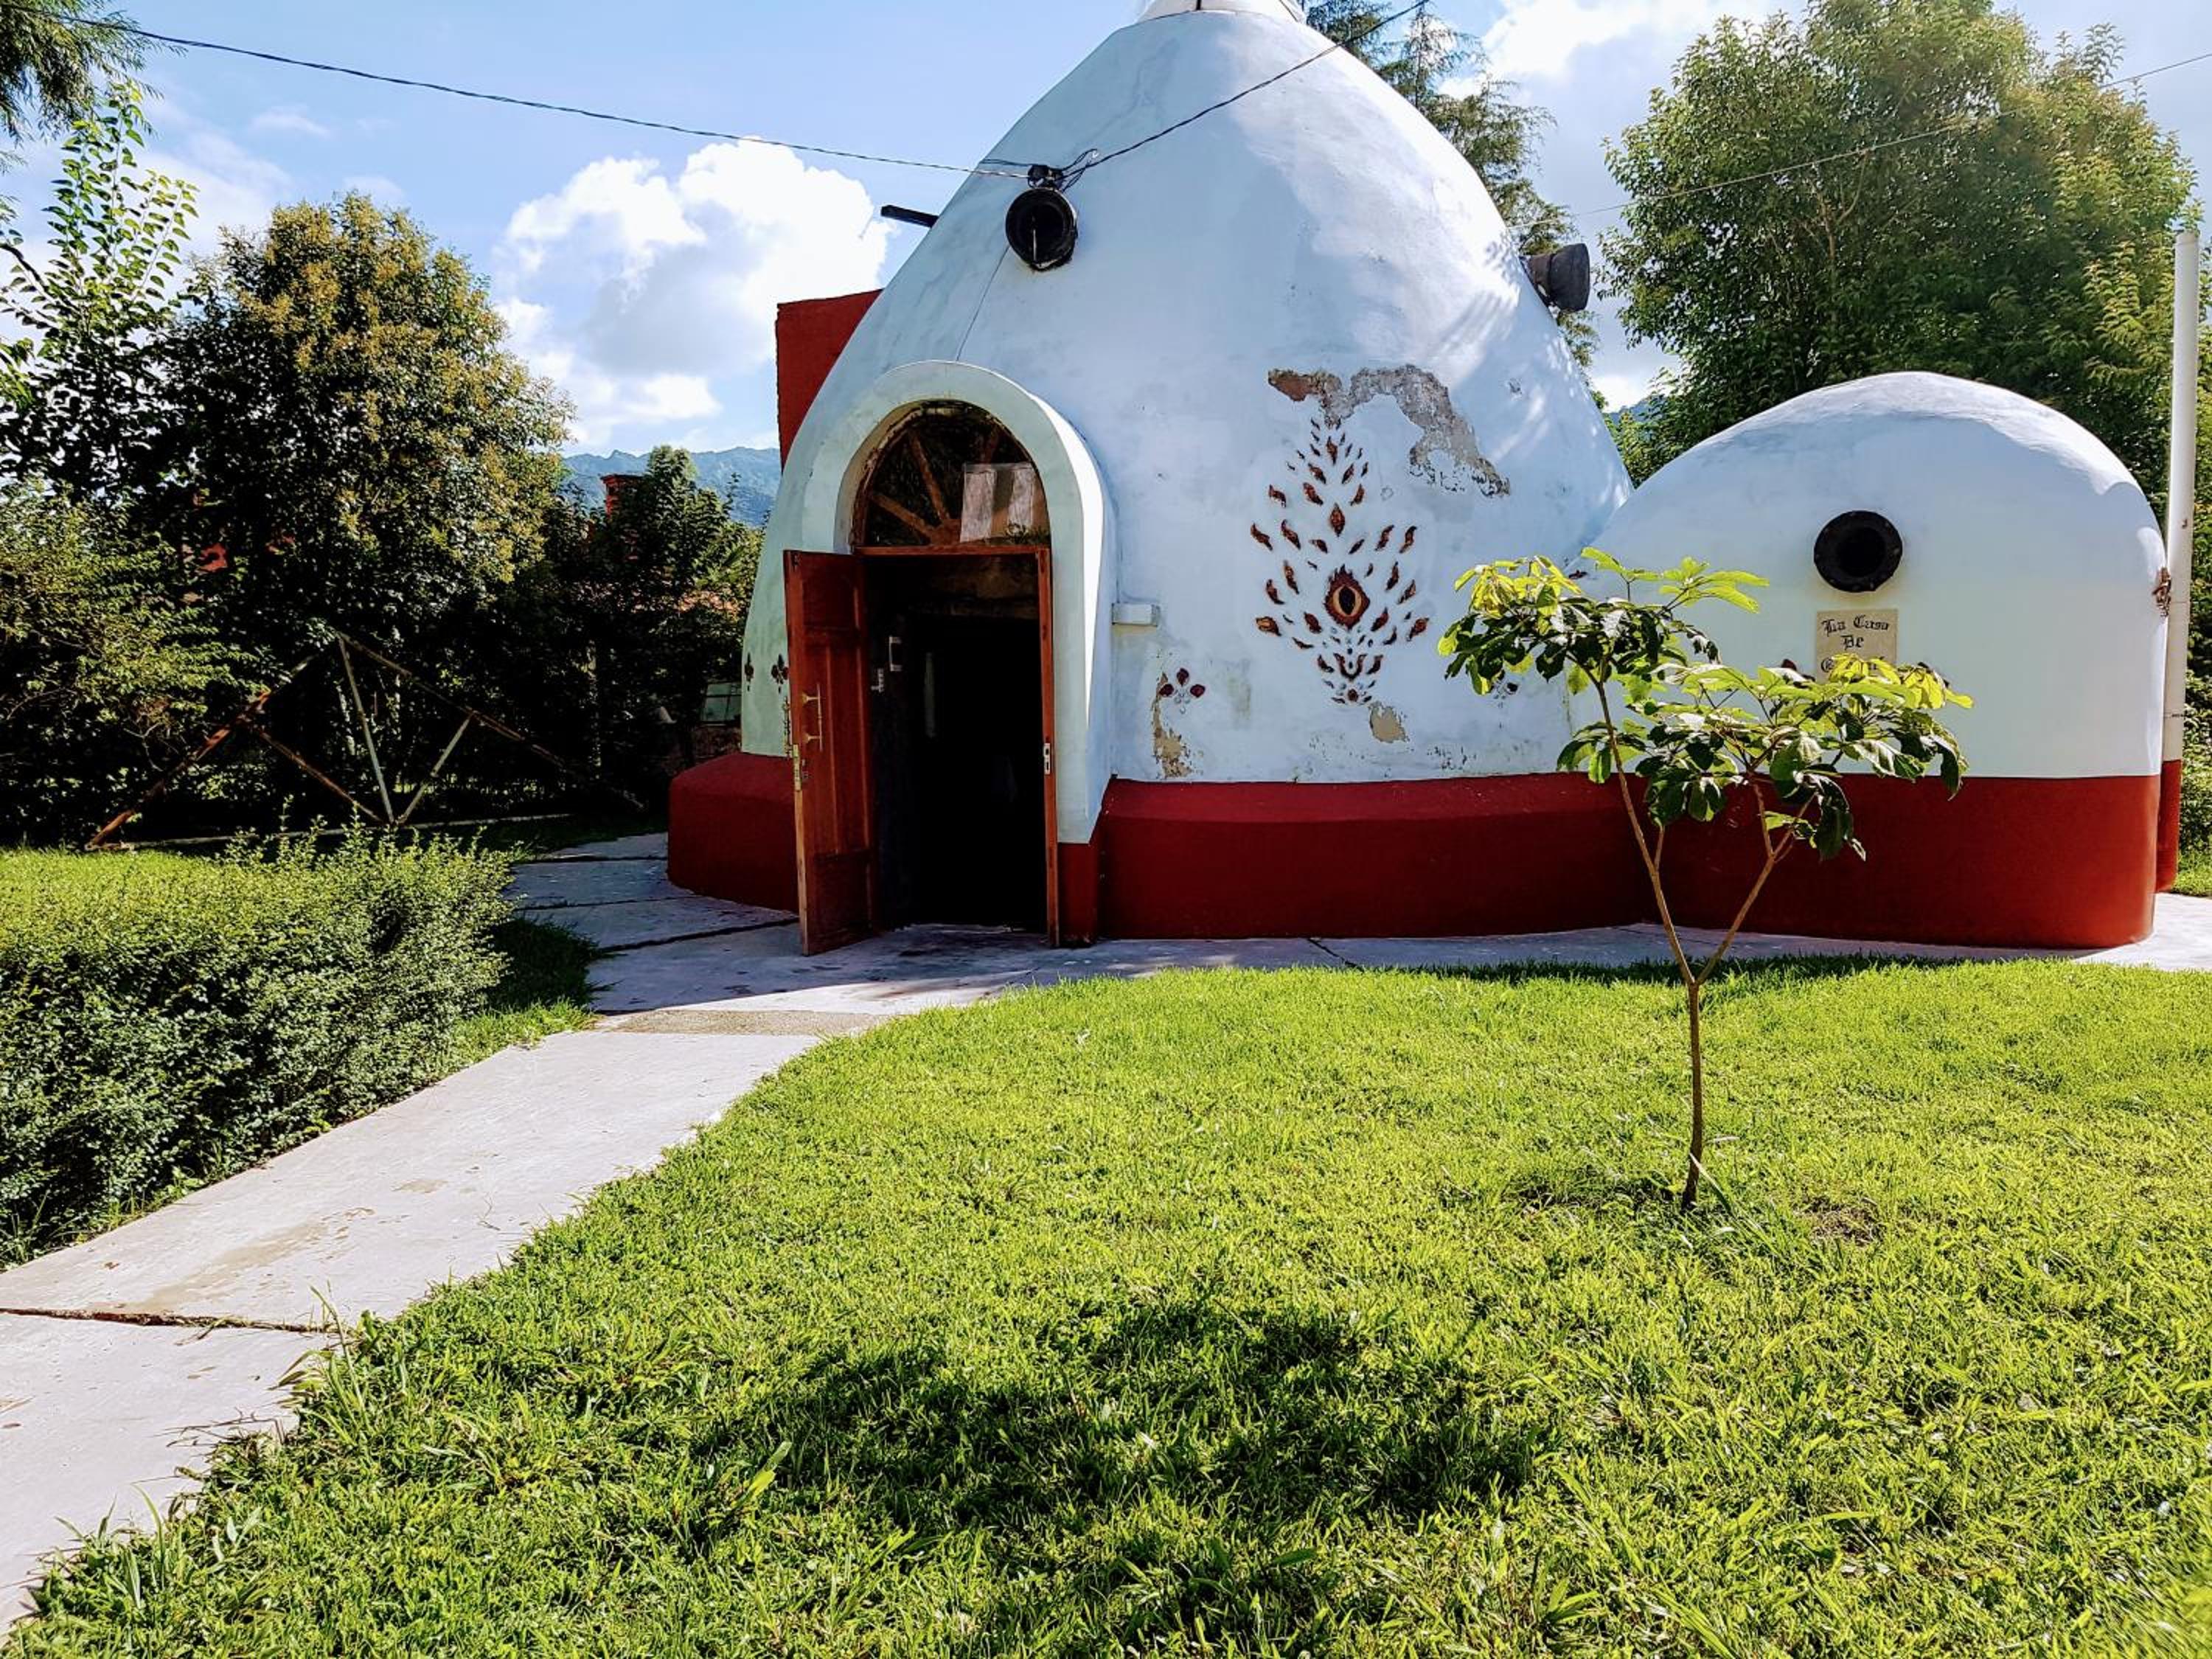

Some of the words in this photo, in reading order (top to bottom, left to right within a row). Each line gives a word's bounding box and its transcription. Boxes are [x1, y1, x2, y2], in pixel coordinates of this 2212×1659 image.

[1821, 619, 1846, 637] La
[1853, 614, 1889, 630] Casa
[1840, 635, 1864, 650] De
